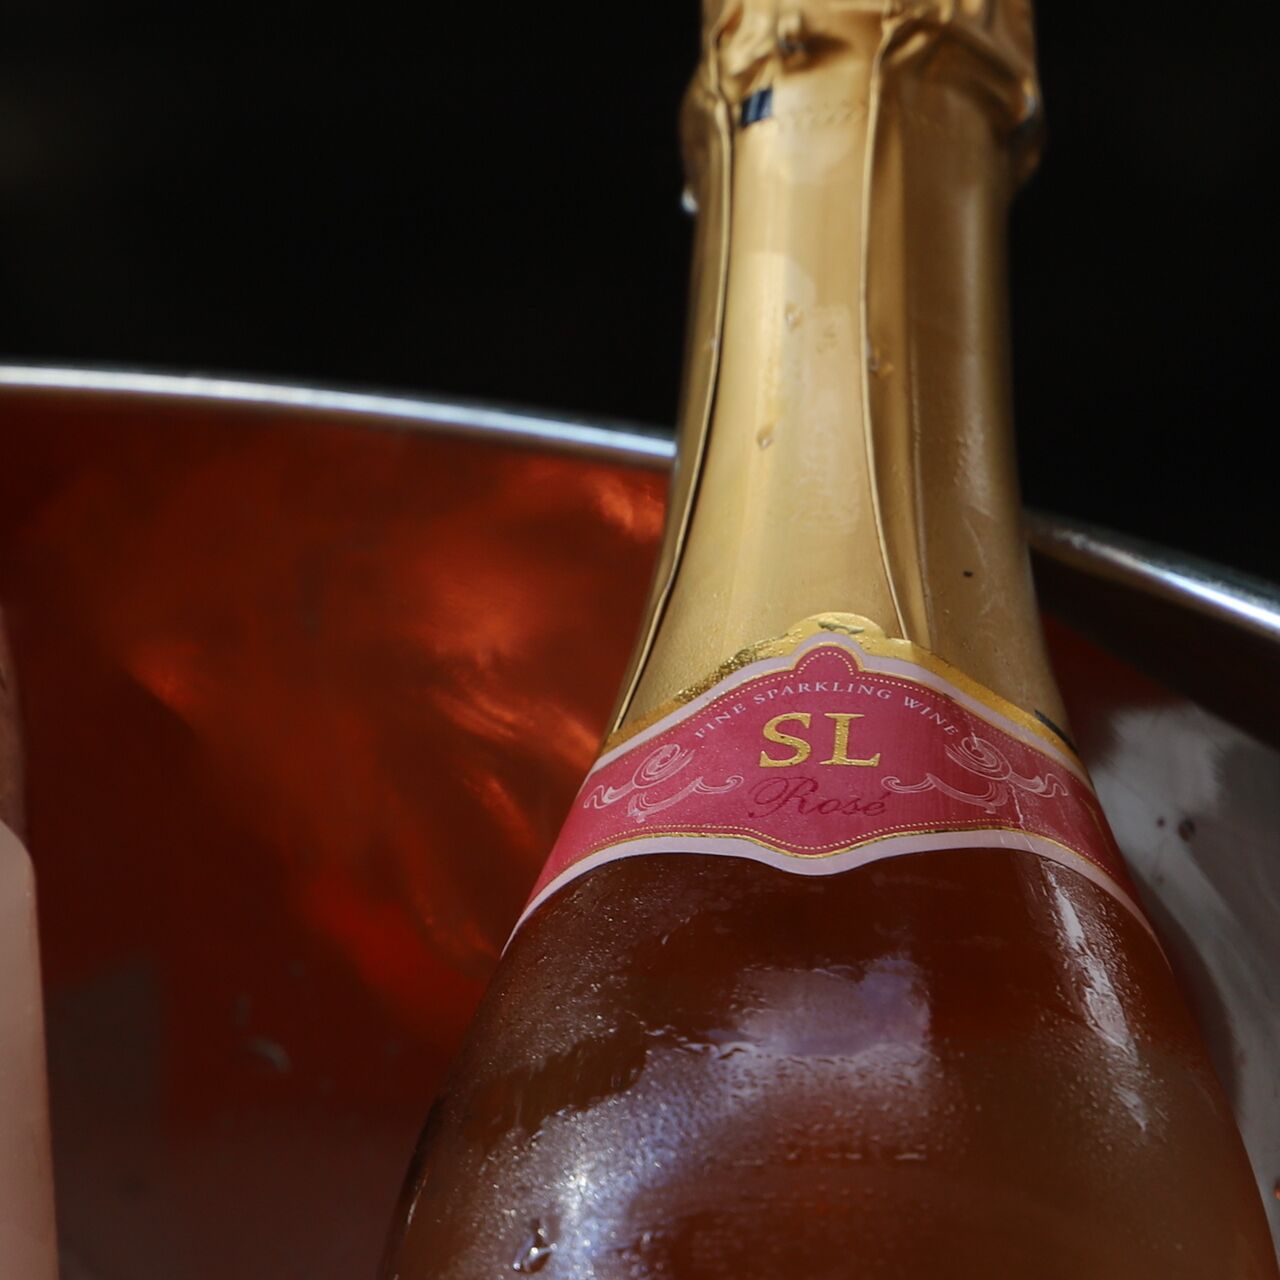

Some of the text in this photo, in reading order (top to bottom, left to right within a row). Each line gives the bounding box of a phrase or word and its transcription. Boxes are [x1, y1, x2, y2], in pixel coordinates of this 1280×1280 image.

[694, 681, 960, 740] FINE SPARKLING WINE
[758, 711, 881, 768] SL
[747, 775, 891, 820] Rosé
